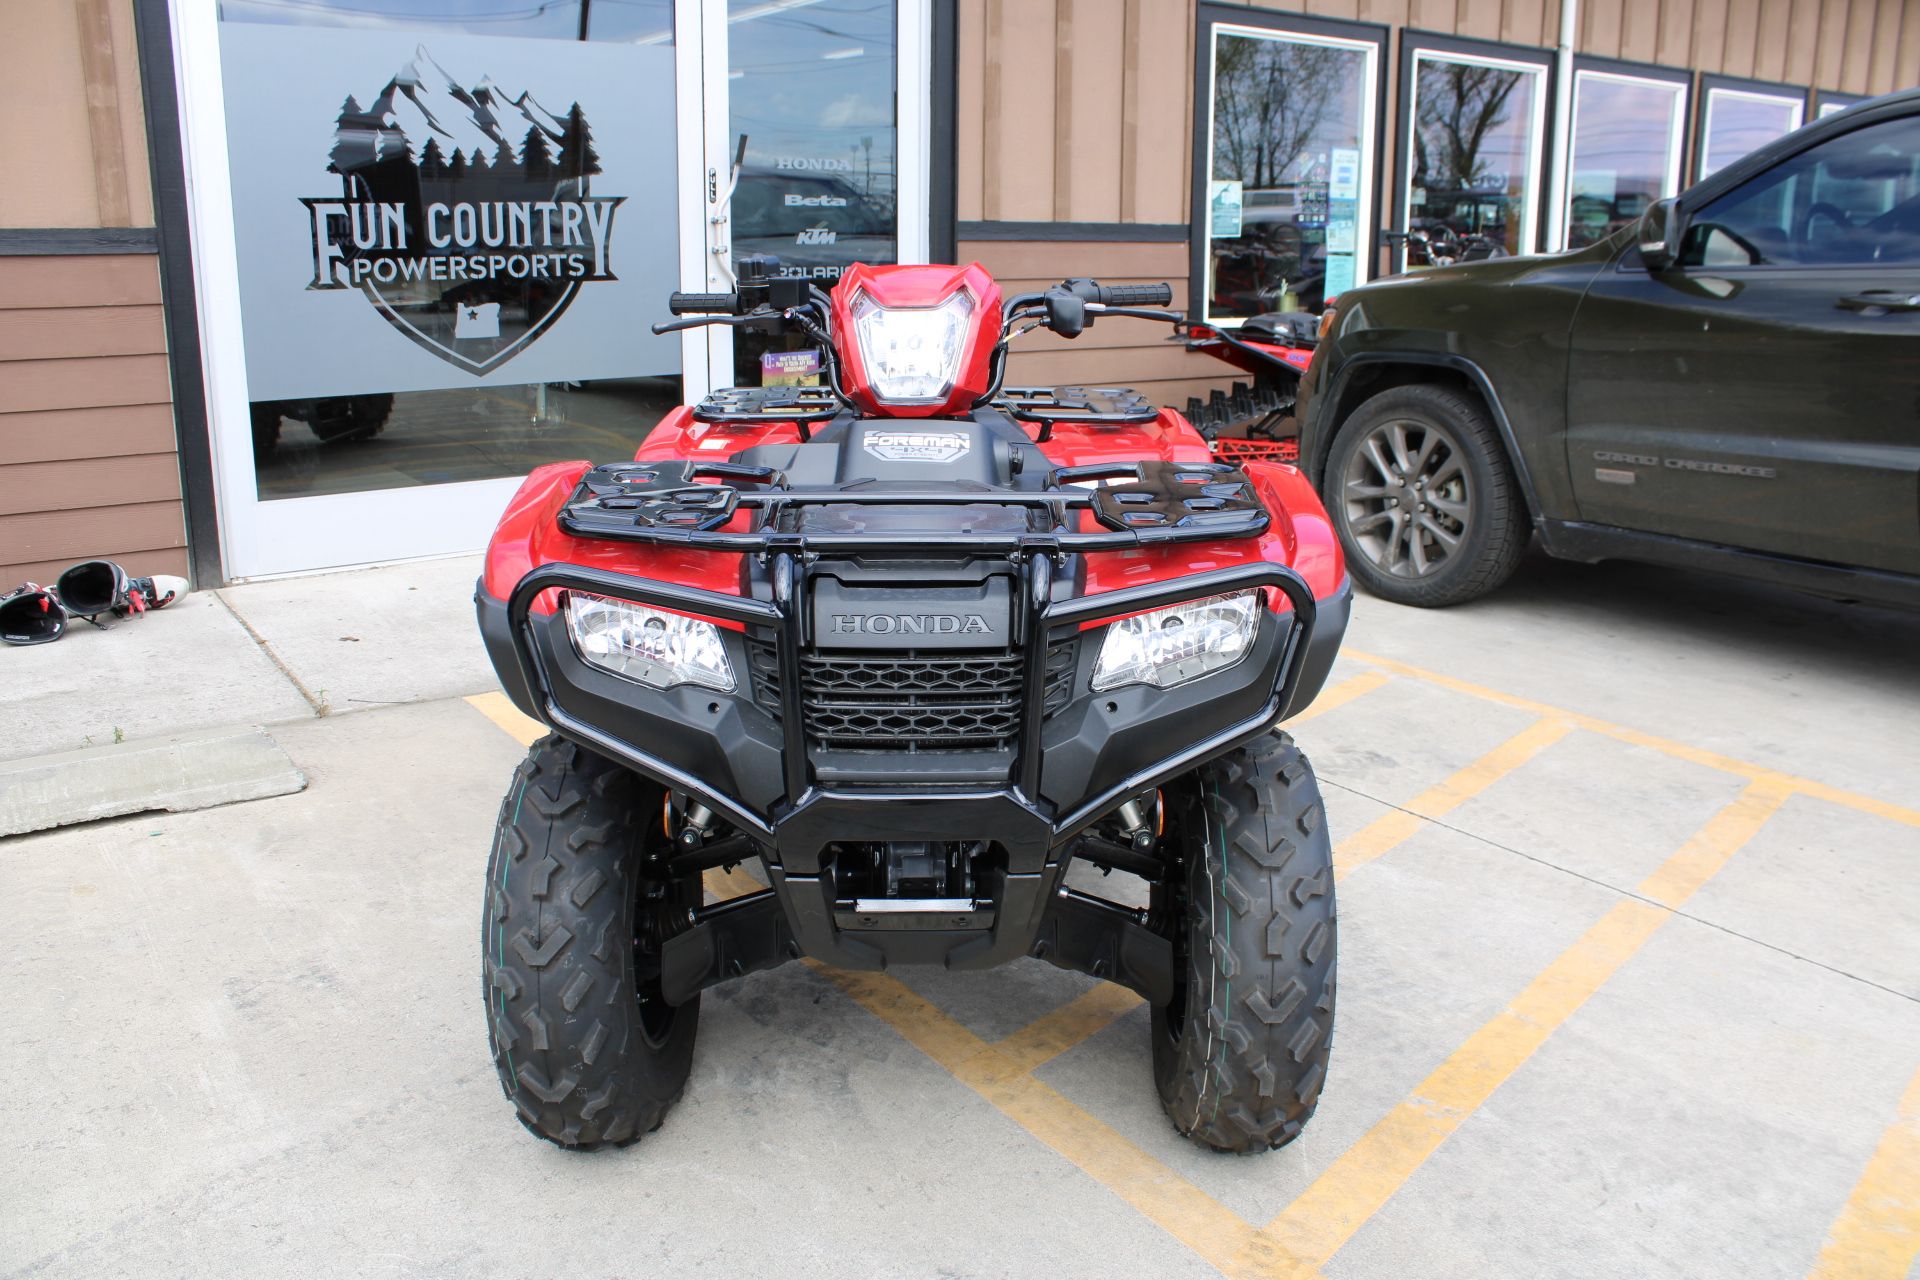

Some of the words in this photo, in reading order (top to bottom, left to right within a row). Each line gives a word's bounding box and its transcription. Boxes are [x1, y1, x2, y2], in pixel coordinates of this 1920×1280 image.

[778, 158, 852, 170] HONDA
[784, 194, 847, 207] Beta
[312, 202, 408, 285] FUN
[427, 201, 614, 277] COUNTRY
[796, 228, 836, 245] KTM
[354, 254, 585, 283] POWERSPORTS
[864, 436, 970, 449] FOREMAN
[1665, 459, 1775, 478] CHEROKEE
[831, 614, 994, 634] HONDA
